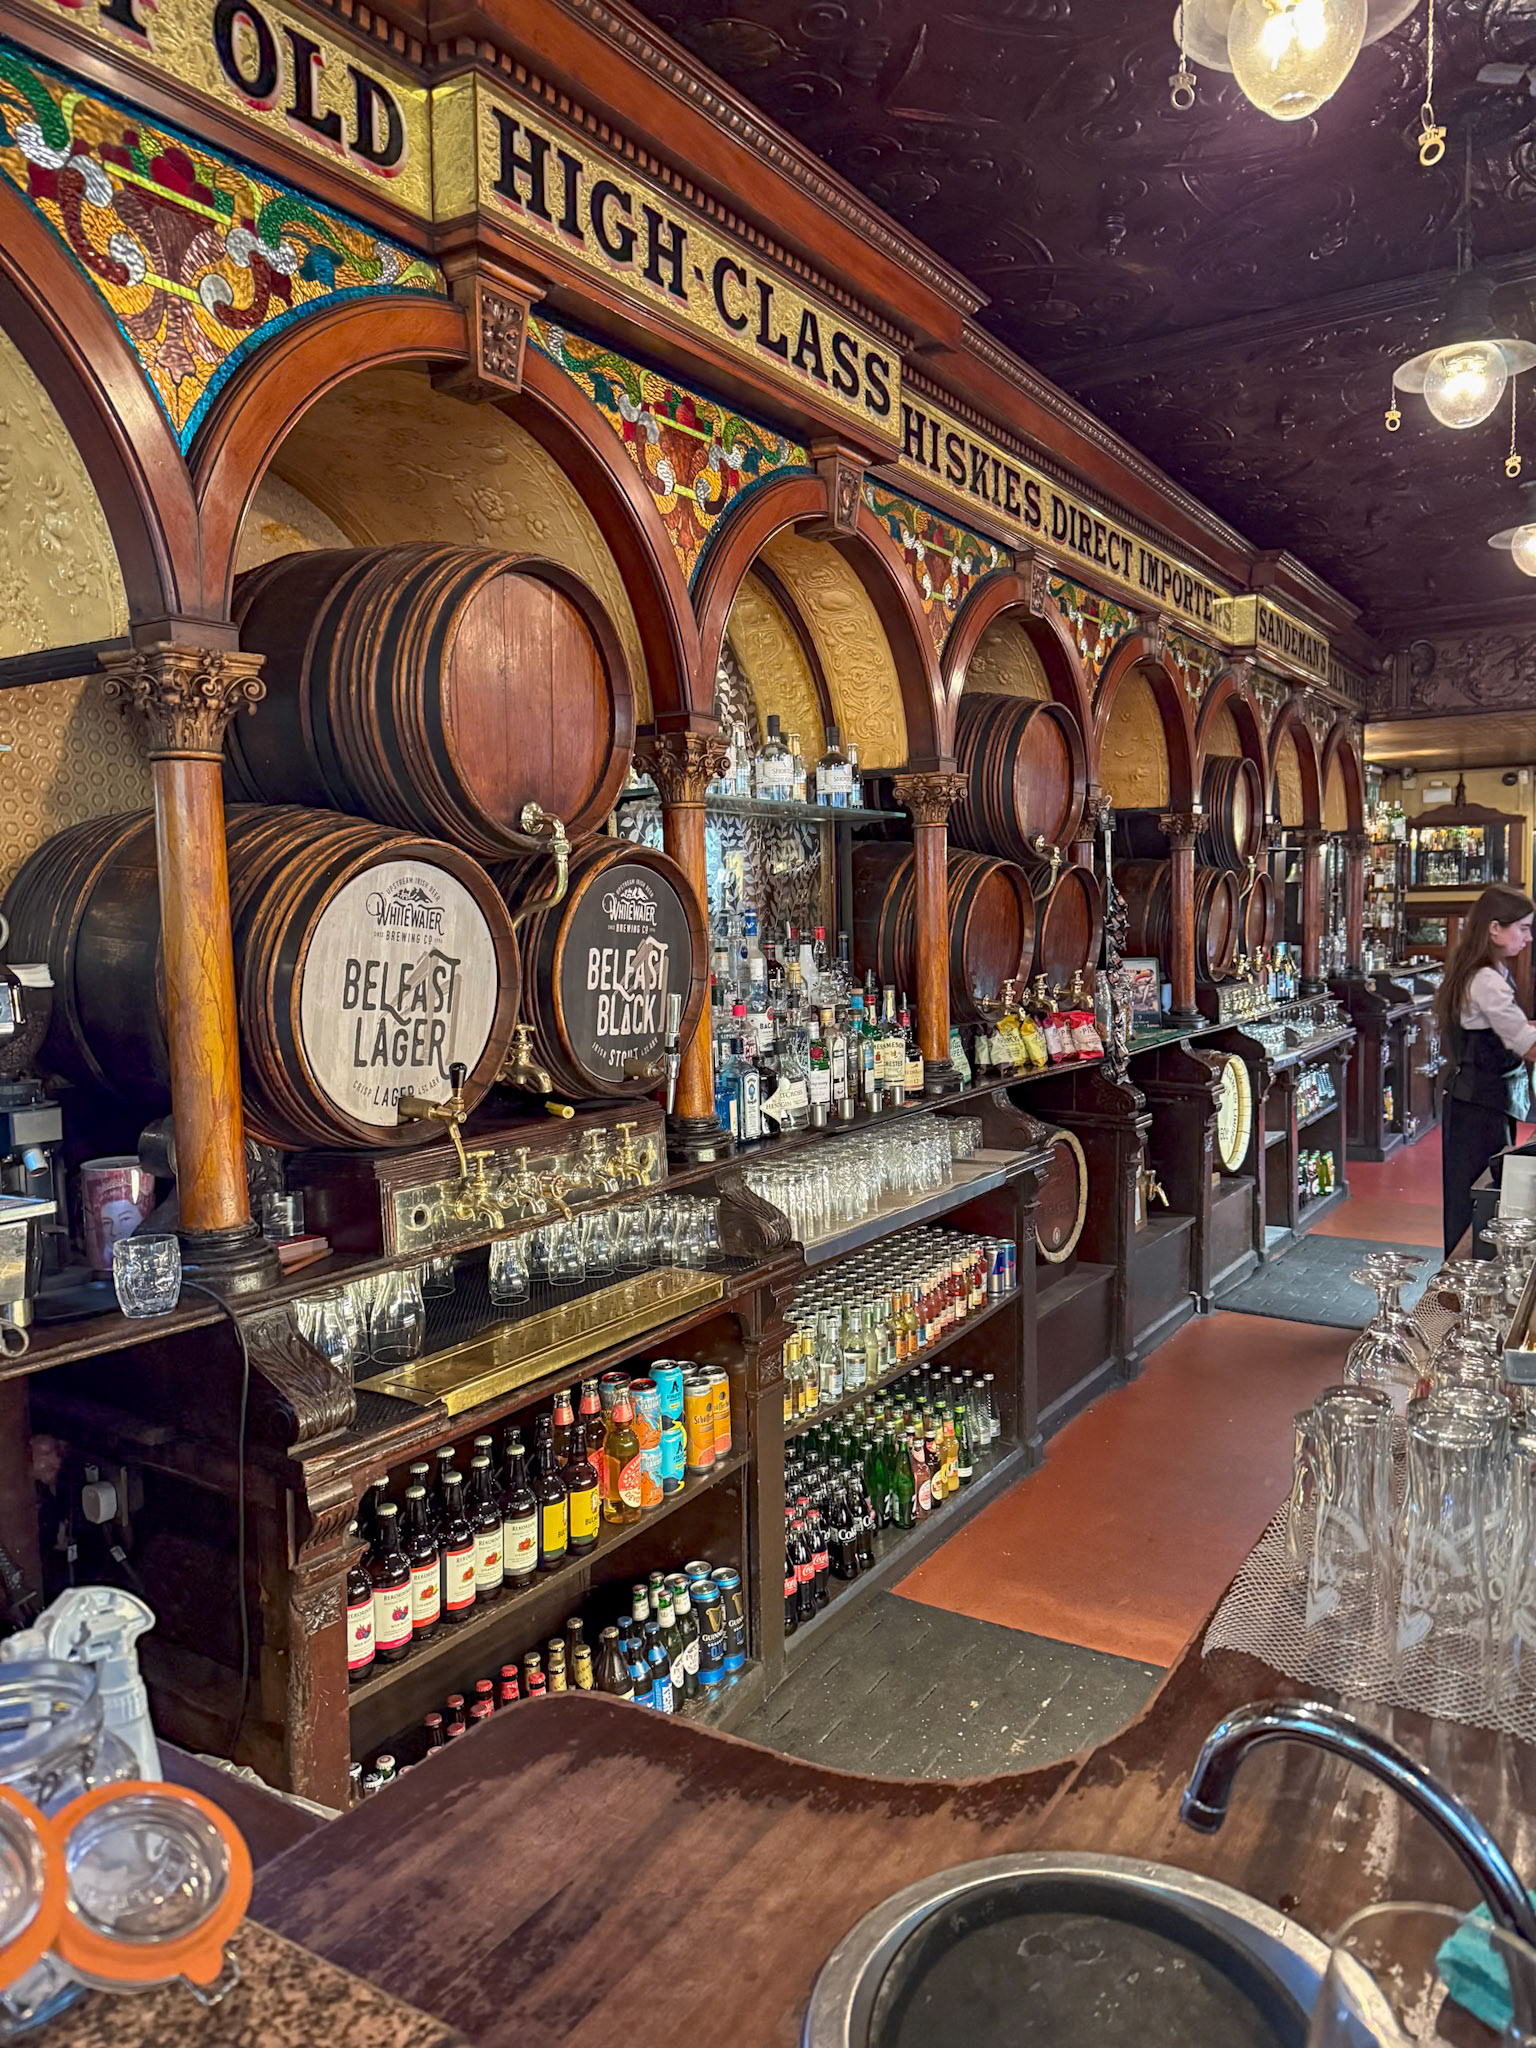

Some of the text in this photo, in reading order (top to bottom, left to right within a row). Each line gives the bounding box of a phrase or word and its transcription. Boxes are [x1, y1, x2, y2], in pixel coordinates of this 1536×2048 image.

[214, 0, 408, 178] OLD
[1051, 494, 1133, 578] DIRECT
[1139, 548, 1232, 633] IMPORTERS
[386, 876, 414, 895] UPSTREAM
[601, 892, 658, 927] WHITEWATER
[366, 891, 446, 936] WHITEWATER
[386, 930, 421, 944] BREWING
[342, 947, 461, 1026] BELFAST
[587, 935, 669, 1002] BELFAST
[597, 994, 657, 1037] BLACK
[353, 1016, 451, 1081] LAGER
